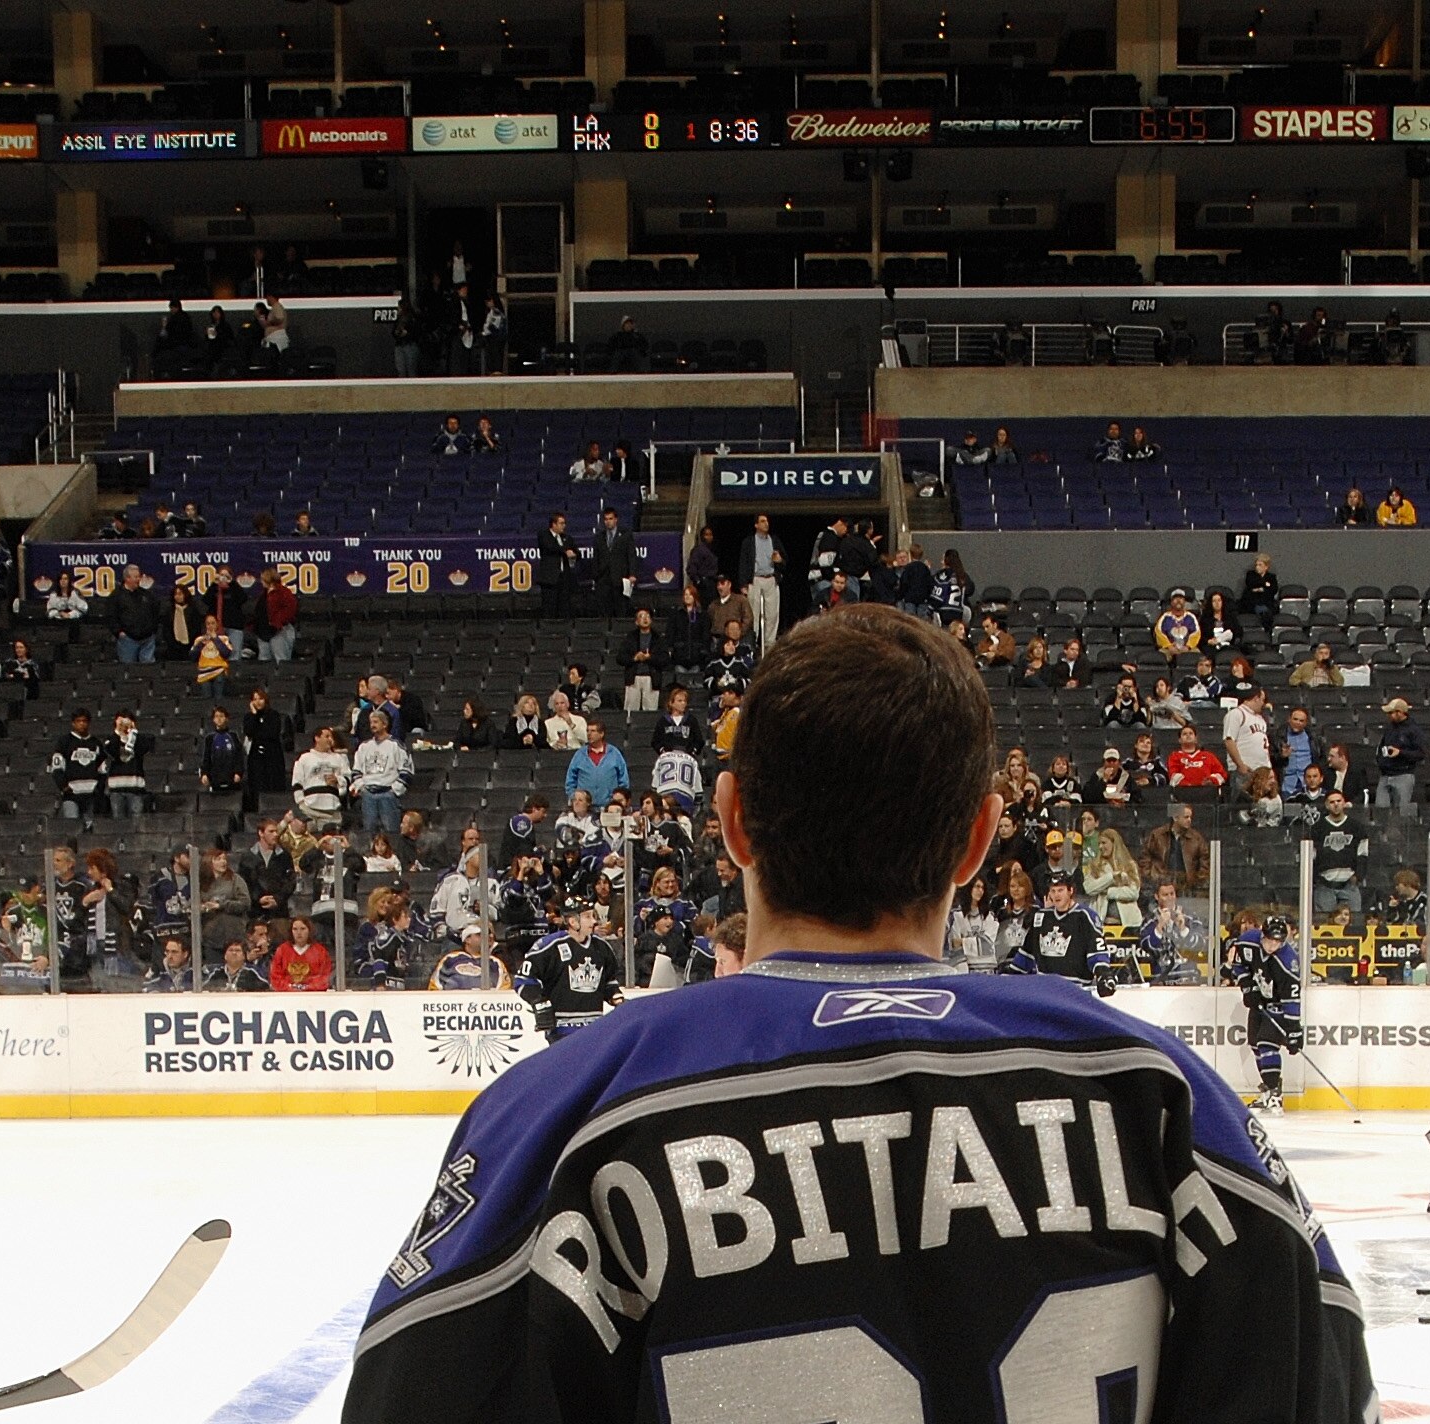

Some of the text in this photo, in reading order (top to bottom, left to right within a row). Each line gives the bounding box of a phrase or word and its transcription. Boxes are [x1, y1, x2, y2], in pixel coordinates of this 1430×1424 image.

[521, 124, 548, 139] at&t
[572, 112, 759, 143] LA 0 1 8:36
[787, 113, 930, 142] Budweiser
[1022, 119, 1084, 132] TICKET
[1253, 109, 1377, 138] STAPLES
[61, 131, 236, 151] ASSIL EYE INSTITUTE
[309, 128, 388, 143] McDonald's
[449, 125, 477, 141] at&t
[572, 132, 659, 152] PHX 0
[1131, 298, 1157, 312] PR14
[373, 308, 399, 322] PR13
[754, 470, 874, 486] DIRECTV
[1234, 534, 1251, 550] 111
[59, 552, 128, 566] THANK YOU
[161, 551, 230, 565] THANK YOU
[263, 549, 331, 564] THANK YOU
[373, 548, 443, 563] THANK YOU
[475, 547, 518, 561] THANK
[73, 565, 116, 598] 20
[175, 564, 218, 597] 20
[277, 562, 320, 595] 20
[386, 560, 430, 594] 20
[489, 560, 533, 592] 20
[658, 760, 696, 787] 20
[423, 999, 524, 1013] RESORT & CASINO
[144, 1010, 393, 1046] PECHANGA
[422, 1015, 524, 1032] PECHANGA
[145, 1048, 395, 1073] RESORT & CASINO
[528, 1098, 1234, 1354] ROBITAIL
